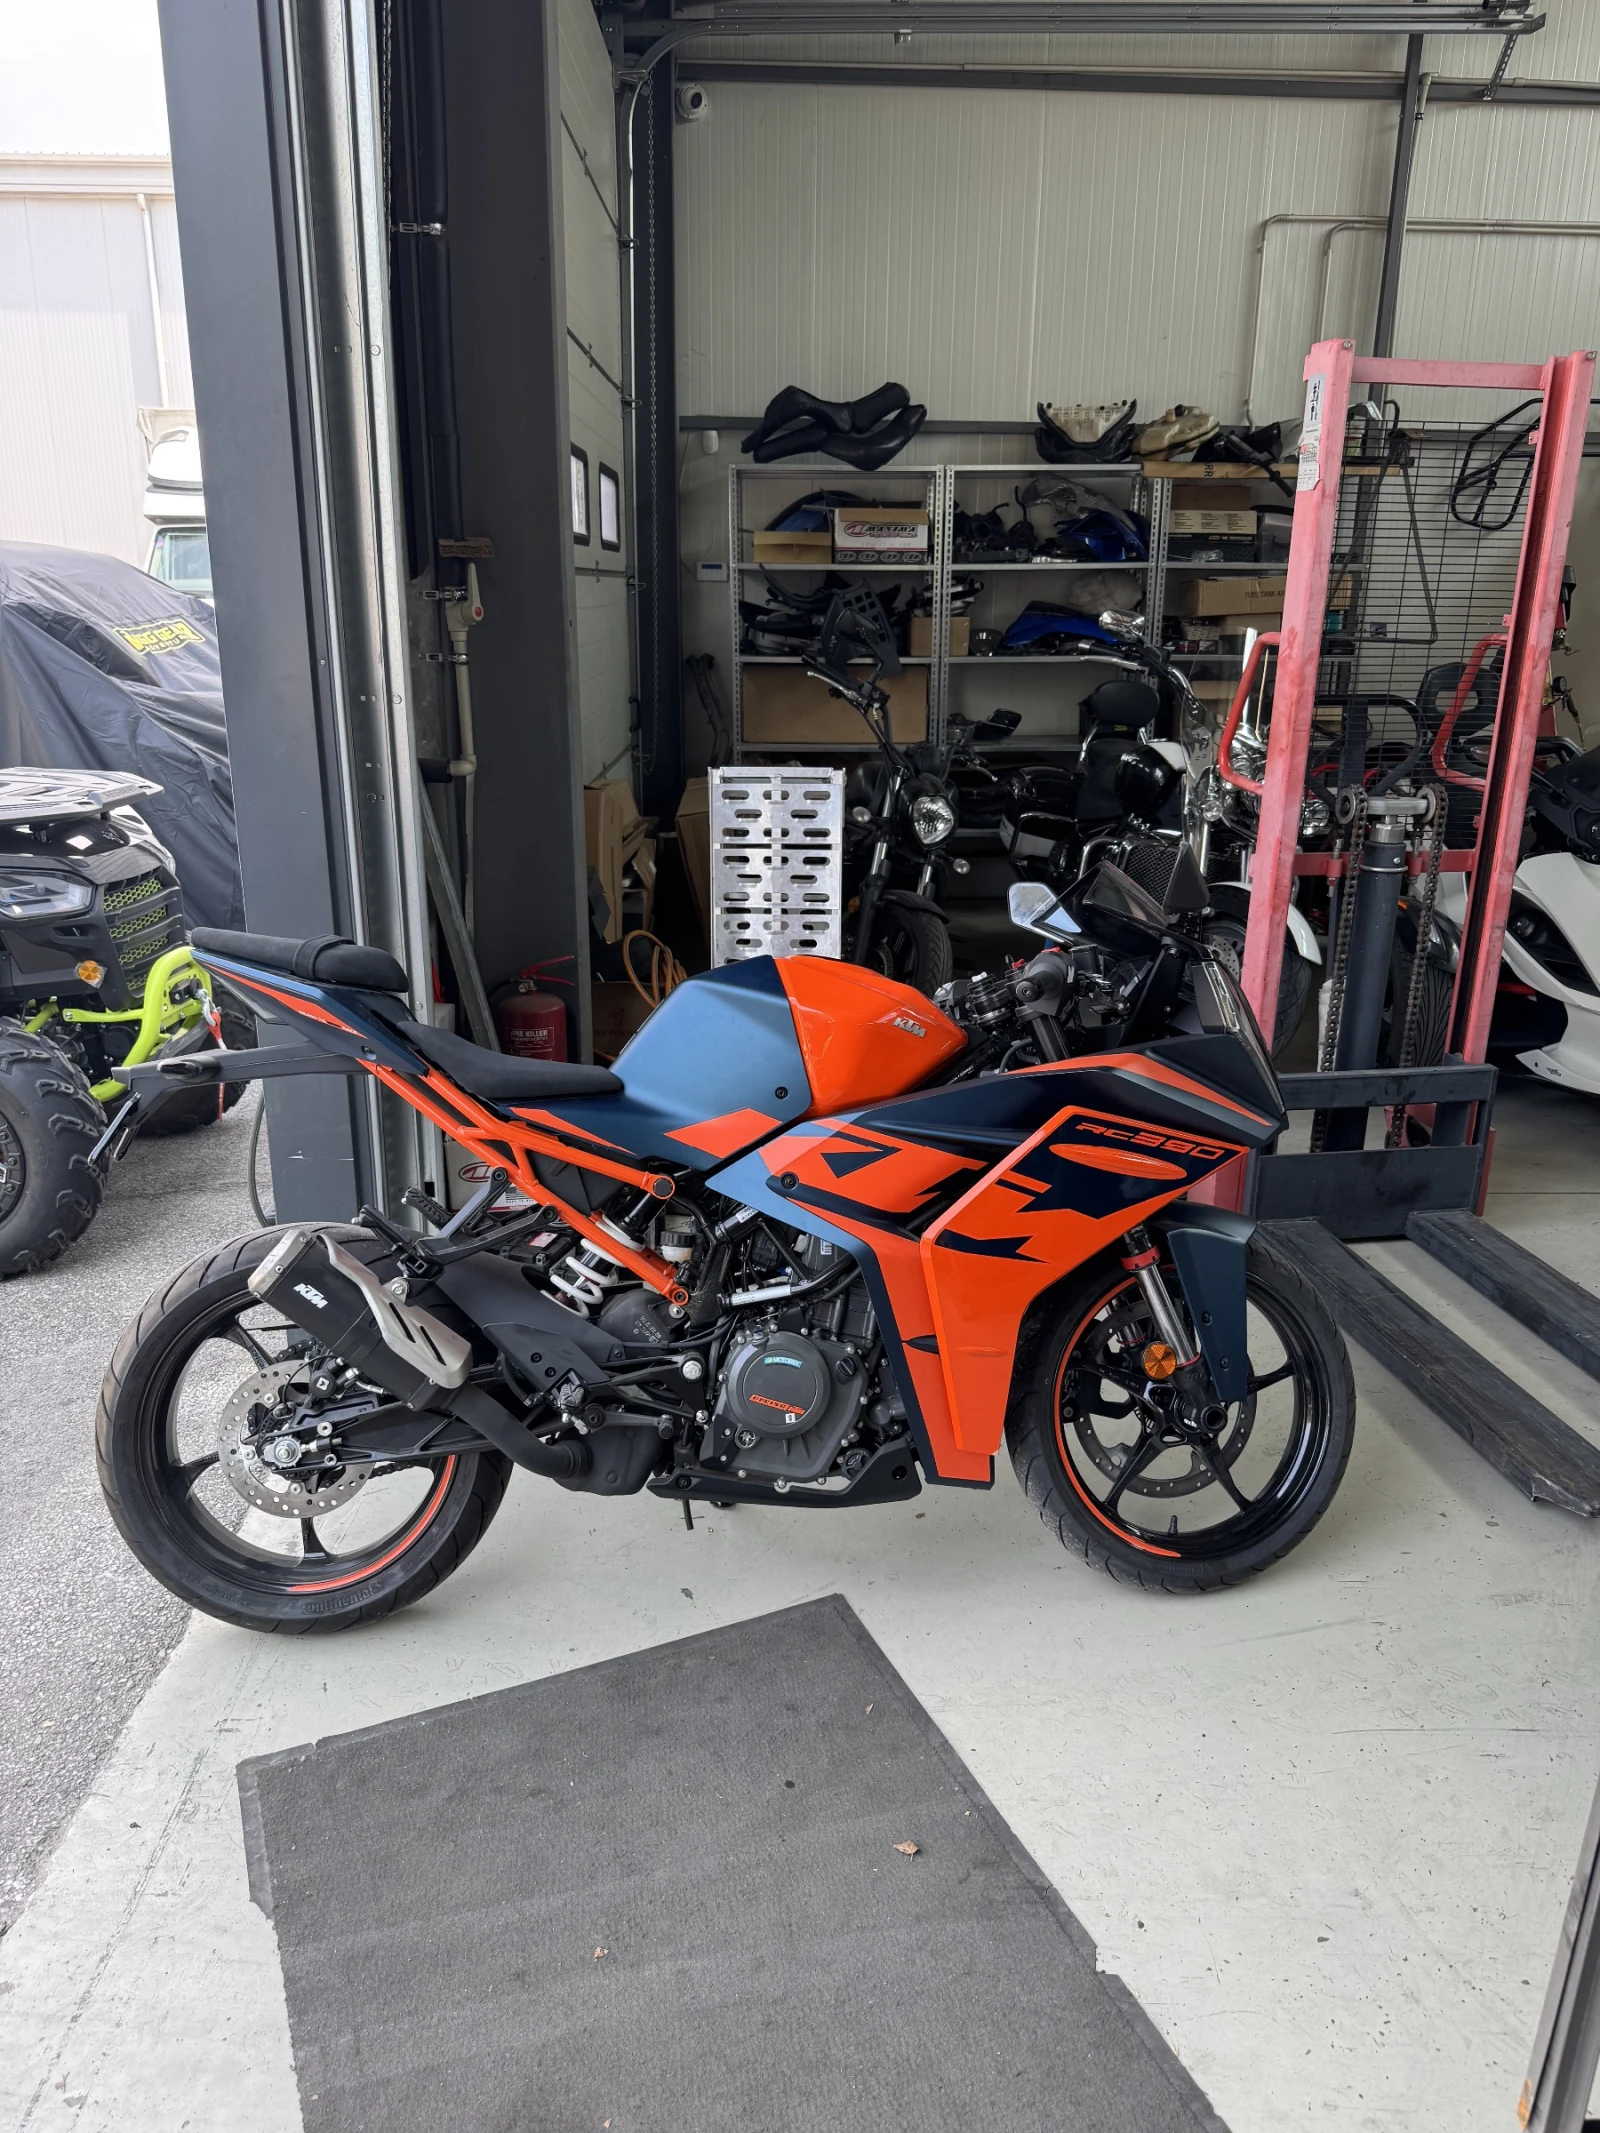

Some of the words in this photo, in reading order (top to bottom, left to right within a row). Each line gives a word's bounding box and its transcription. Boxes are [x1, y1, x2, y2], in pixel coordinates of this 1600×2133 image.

[865, 525, 916, 533] MAXIMA
[893, 1017, 926, 1037] KTM
[293, 1283, 328, 1308] KTM
[301, 1583, 377, 1614] Continental
